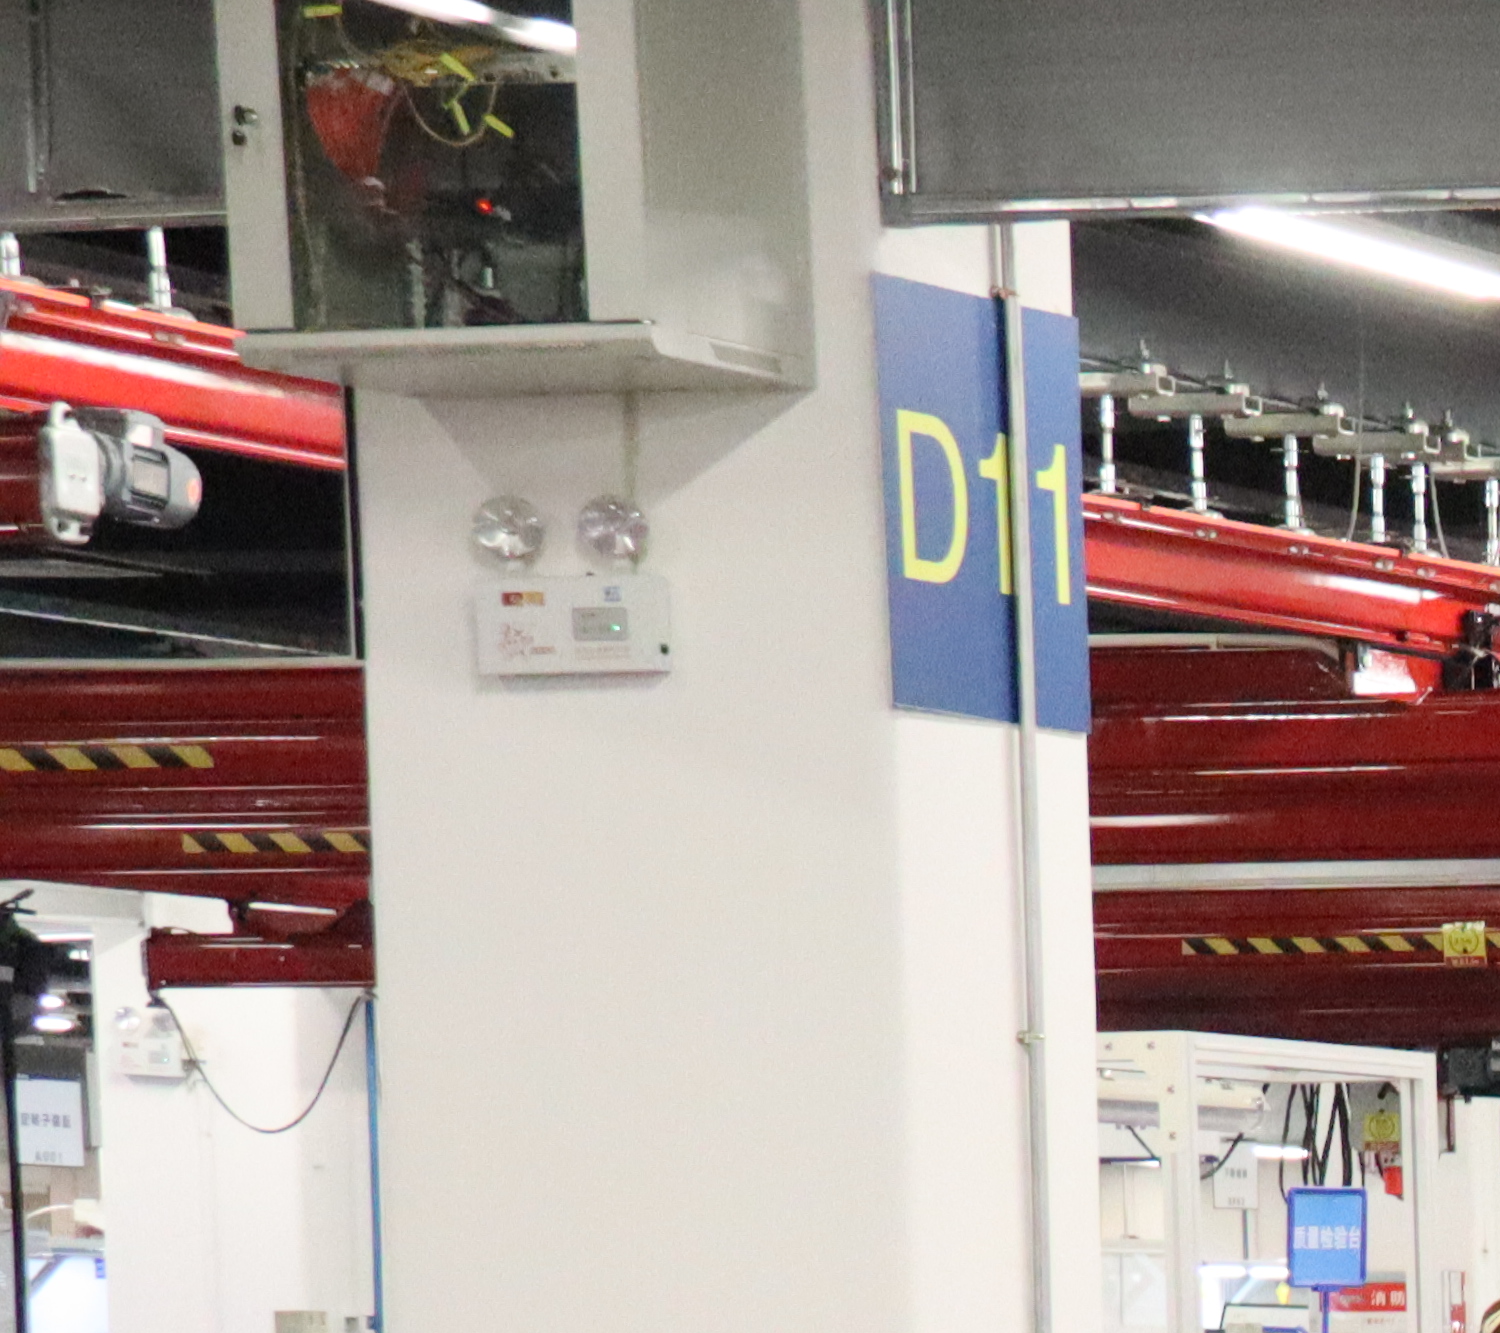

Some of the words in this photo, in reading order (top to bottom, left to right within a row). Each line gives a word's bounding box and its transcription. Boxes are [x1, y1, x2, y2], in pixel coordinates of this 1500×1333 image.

[897, 409, 1071, 606] D11
[1294, 1225, 1360, 1250] 质量检验台
